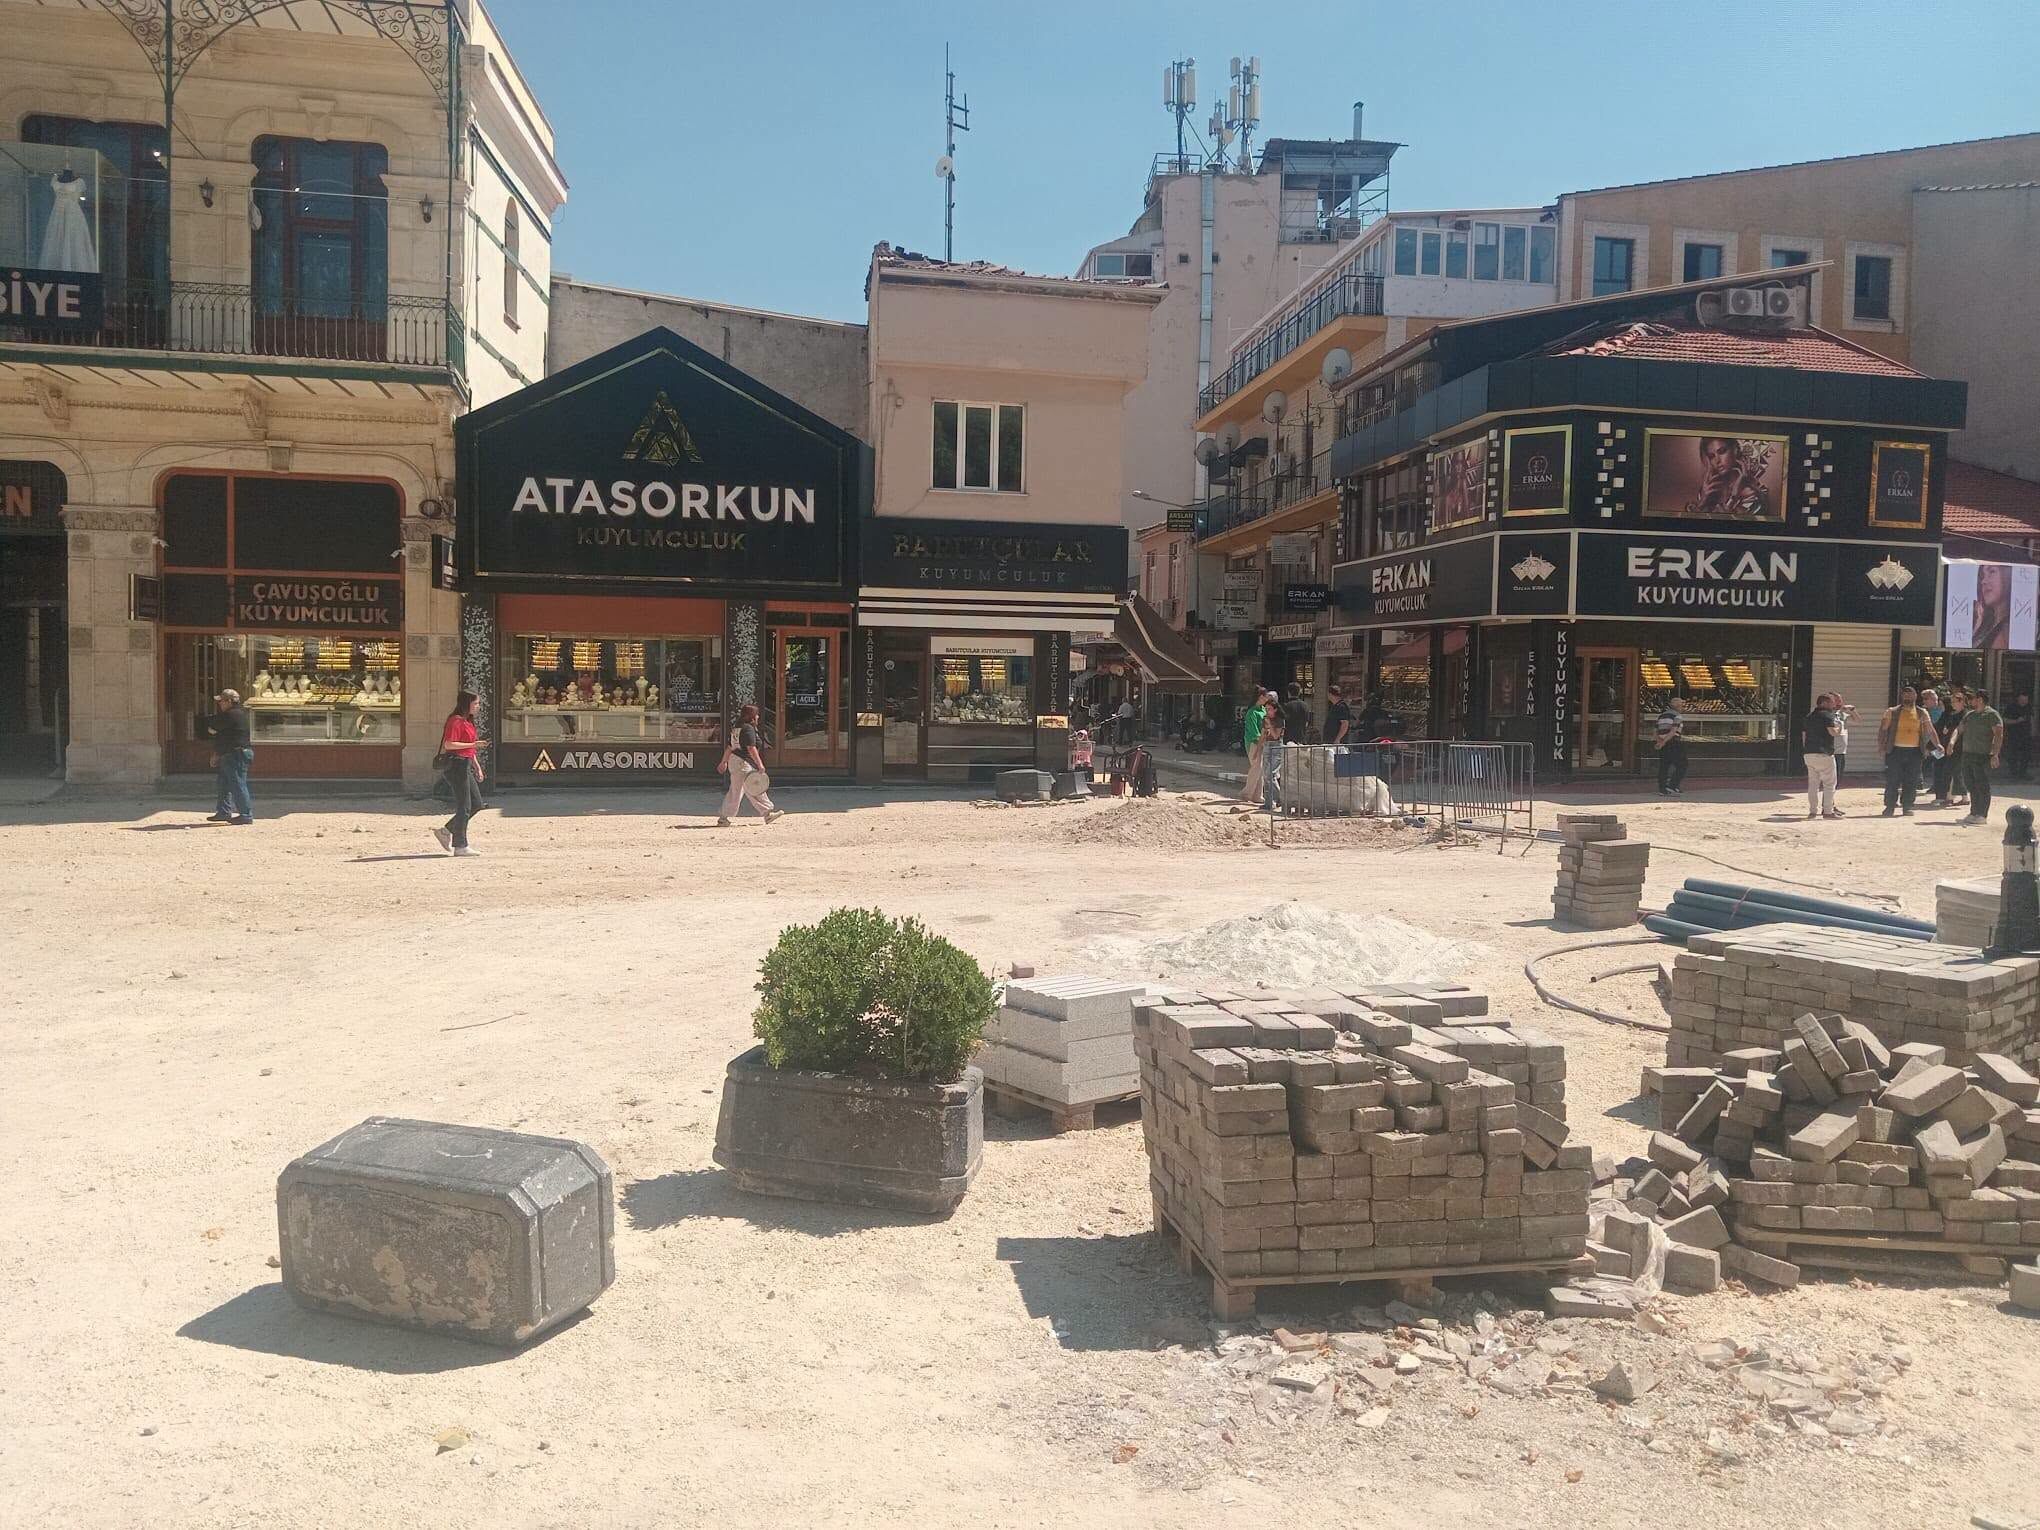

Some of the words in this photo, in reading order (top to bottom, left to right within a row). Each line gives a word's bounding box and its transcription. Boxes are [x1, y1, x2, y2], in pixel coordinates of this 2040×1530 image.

[1522, 474, 1552, 484] ERKAN
[511, 477, 815, 523] ATASORKUN
[1887, 488, 1913, 497] ERKAN
[577, 527, 747, 550] KUYUMCULUK
[920, 568, 1066, 583] KUYUMCULUK
[1627, 547, 1798, 583] ERKAN
[1372, 560, 1431, 593] ERKAN
[252, 581, 379, 604] ÇAVUŞOĞLU
[1287, 590, 1325, 598] ERKAN
[1637, 586, 1785, 607] KUYUMCULUK
[239, 603, 389, 624] KUYUMCULUK
[1374, 594, 1426, 614] KUYUMCULUK
[1526, 651, 1536, 715] ERKAN
[1553, 631, 1567, 760] KUYUMCULUK
[560, 751, 694, 769] ATASORKUN
